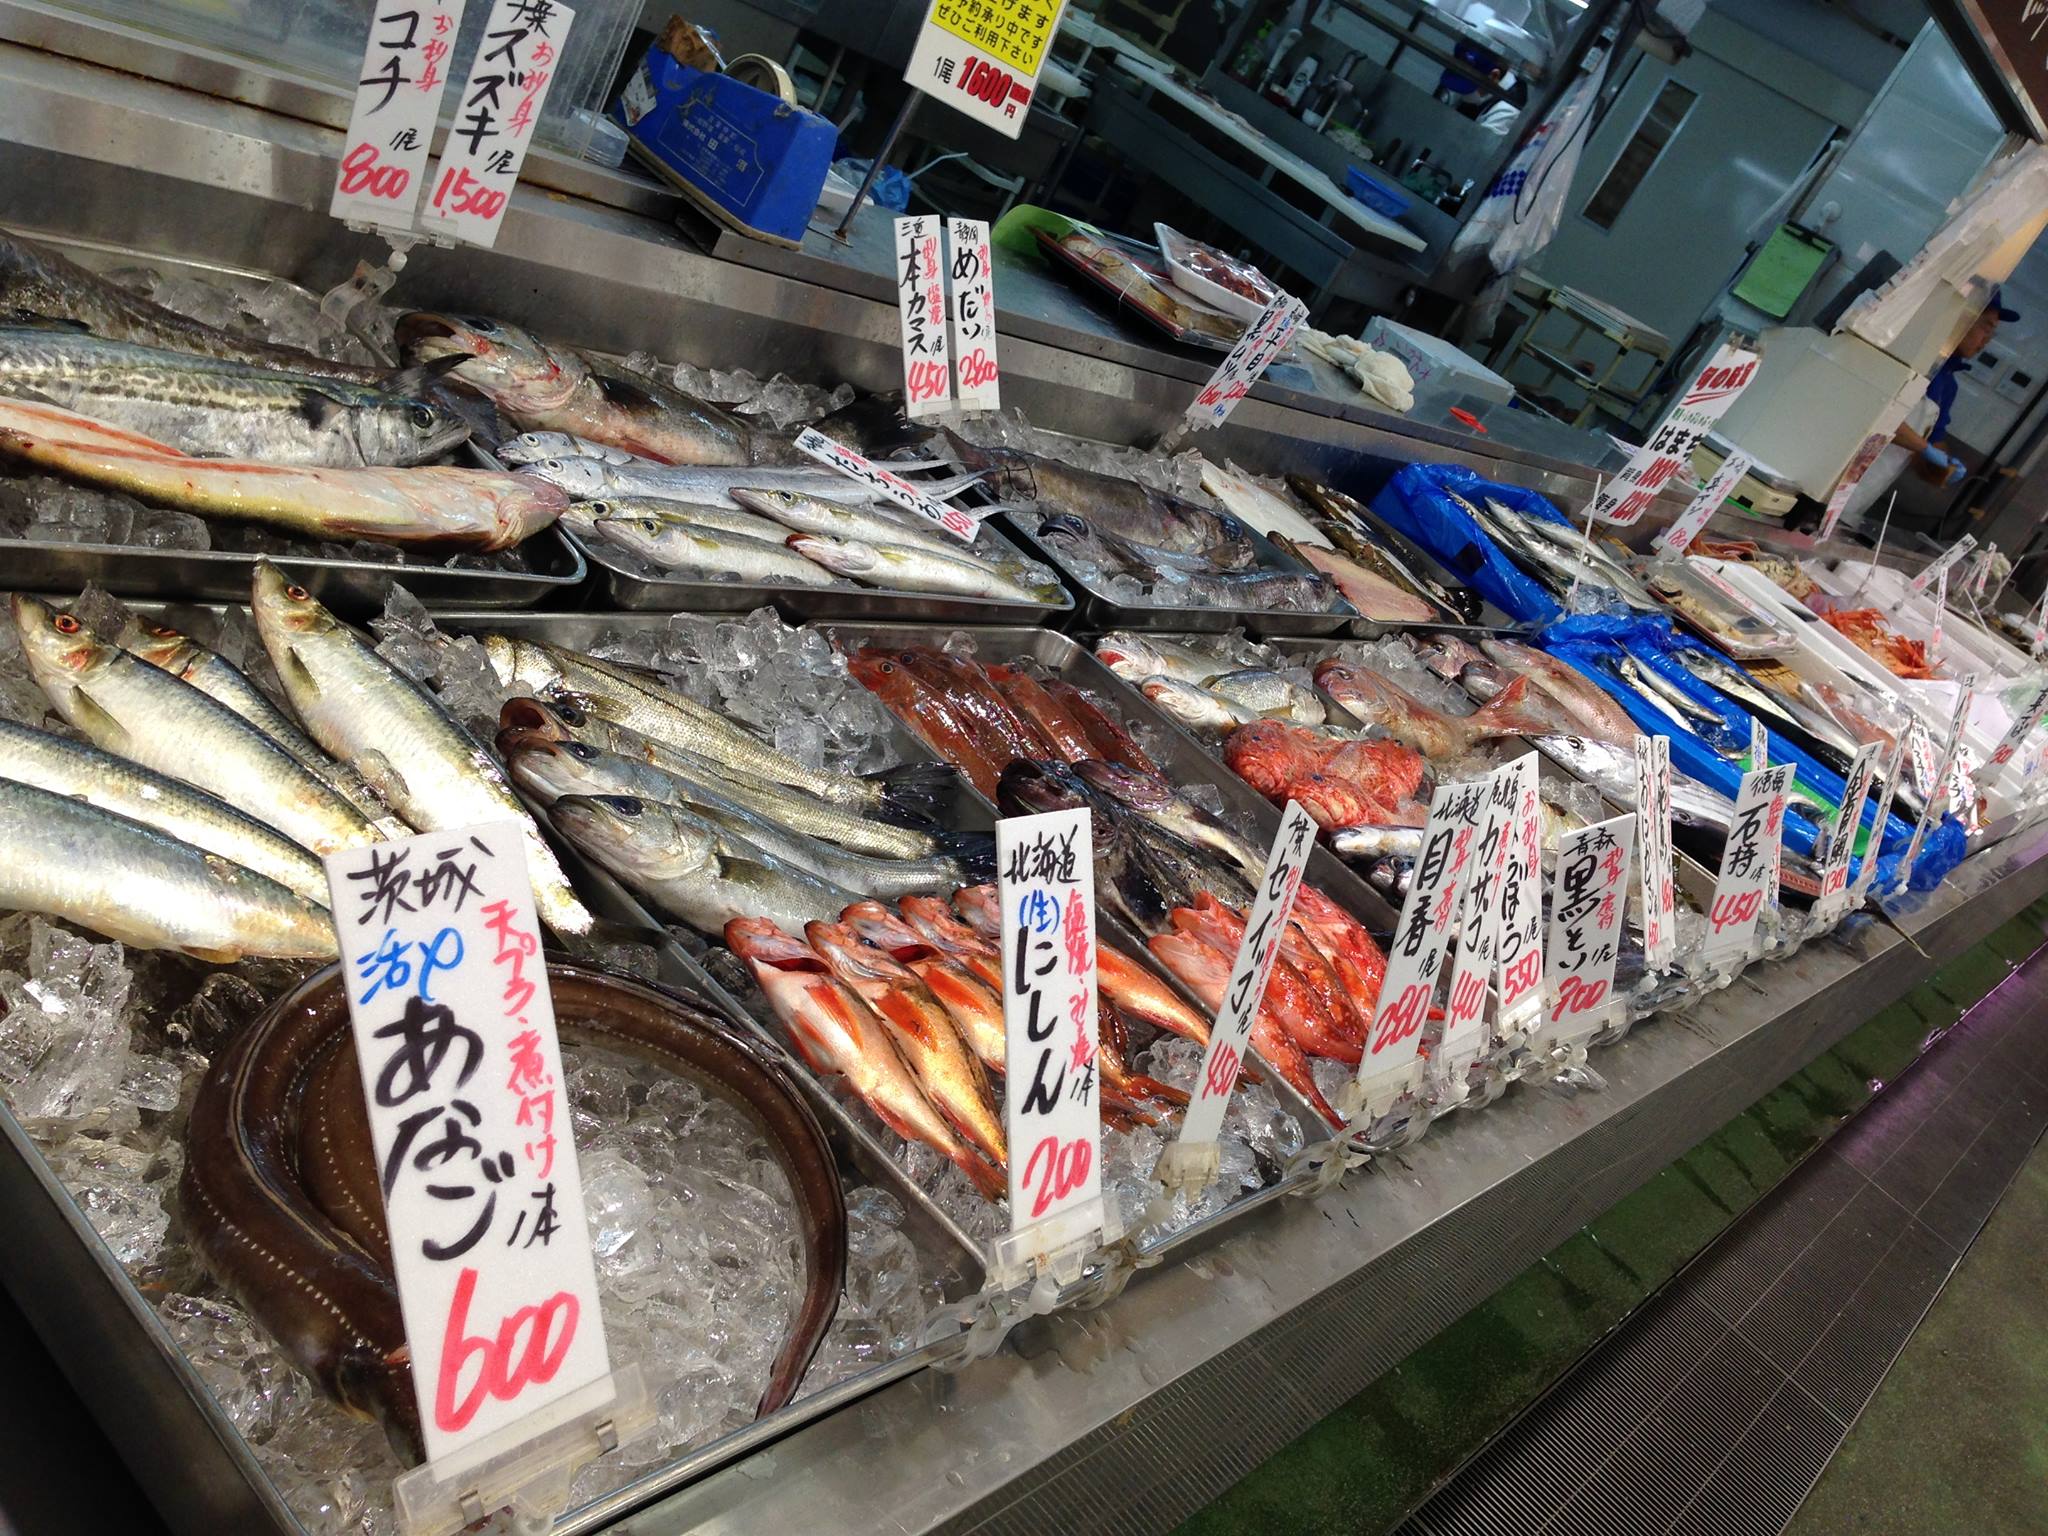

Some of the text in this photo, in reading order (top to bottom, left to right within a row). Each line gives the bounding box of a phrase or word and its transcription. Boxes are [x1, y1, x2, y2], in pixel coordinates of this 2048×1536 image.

[360, 10, 420, 116] コチ
[938, 3, 1033, 64] ぜひご利用下さい
[456, 28, 529, 155] スズキ
[934, 56, 956, 84] 1尾
[956, 56, 1014, 108] 1600
[1004, 103, 1016, 119] 円
[340, 142, 409, 199] 800
[900, 238, 928, 356] 本カマス
[952, 247, 985, 340] めだい
[1244, 327, 1284, 371] 平目
[908, 361, 948, 403] 450
[1650, 425, 1703, 462] はまち
[1433, 785, 1487, 826] 北海道
[1003, 824, 1083, 885] 北海道
[1564, 826, 1618, 857] 青森
[1728, 802, 1770, 879] 石持
[347, 835, 495, 925] 茨城
[1711, 889, 1762, 934] 450
[1557, 854, 1601, 972] 黒そい
[1450, 970, 1486, 1029] 400
[1504, 949, 1540, 1005] 550
[1552, 975, 1609, 1022] 700
[1015, 926, 1067, 1116] にしん
[1372, 984, 1431, 1055] 280
[1202, 1039, 1239, 1100] 450
[373, 996, 515, 1261] あなご
[1022, 1136, 1092, 1218] 200
[507, 1181, 562, 1249] 1本
[435, 1266, 580, 1433] 600
